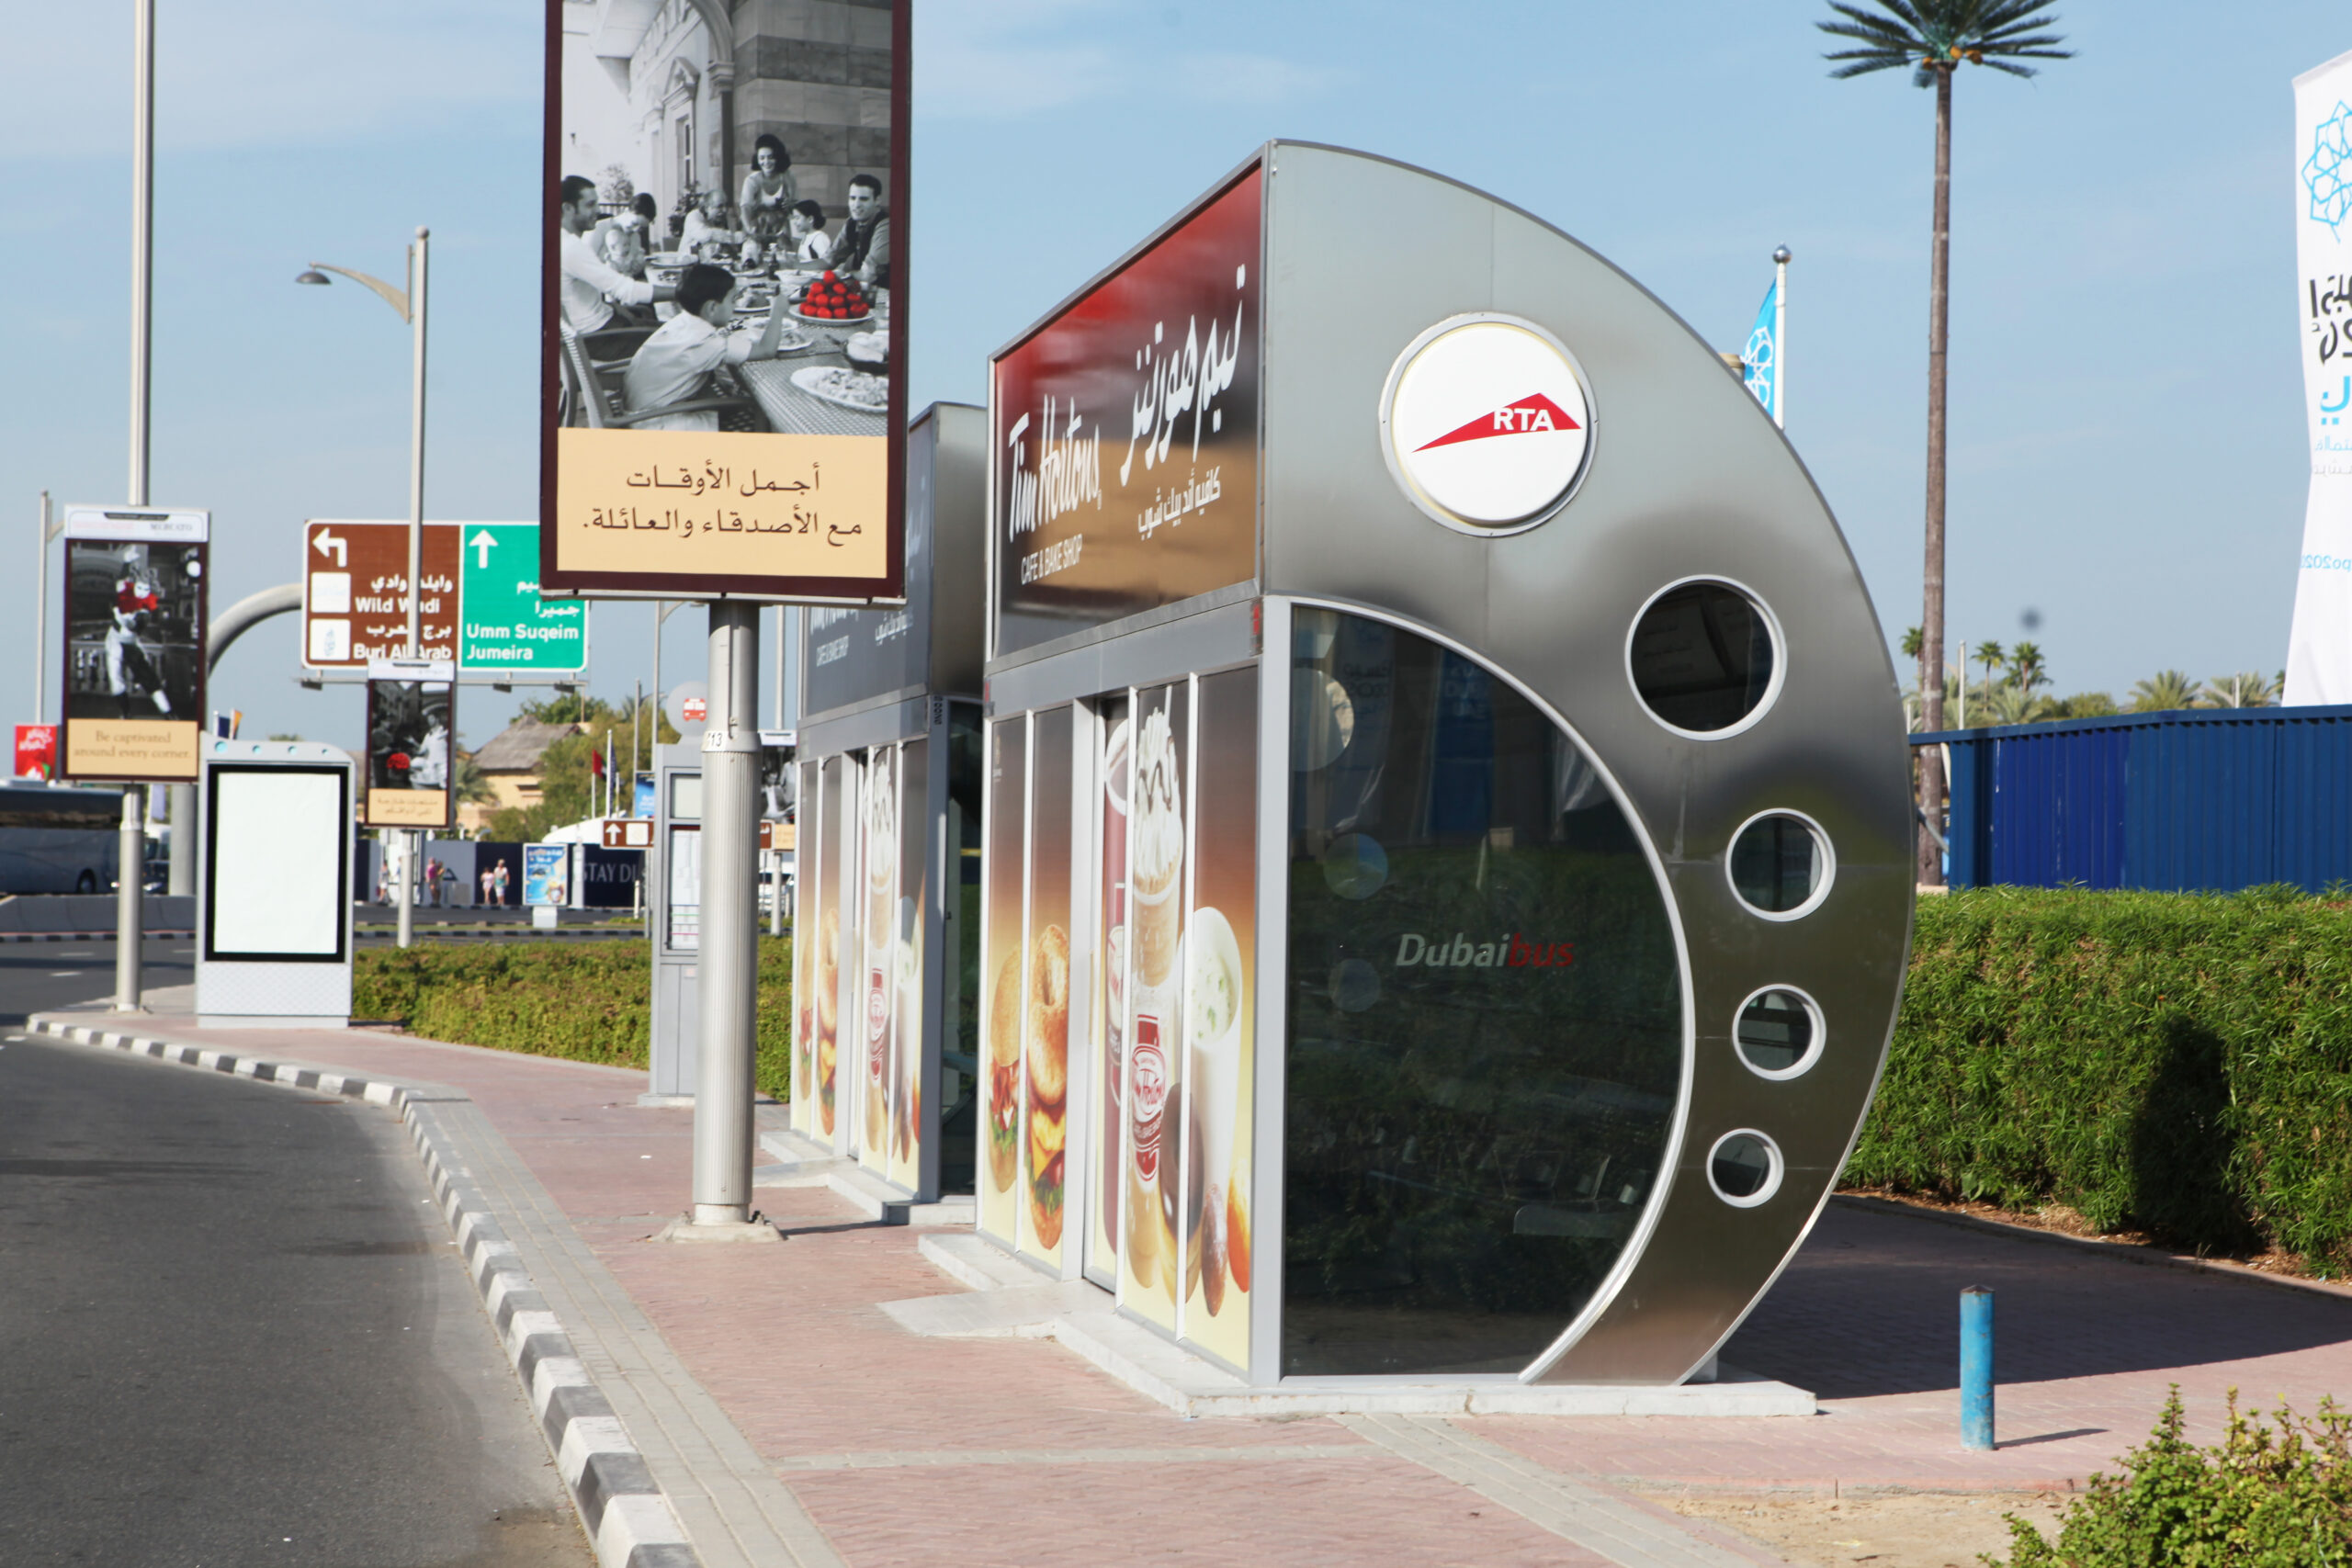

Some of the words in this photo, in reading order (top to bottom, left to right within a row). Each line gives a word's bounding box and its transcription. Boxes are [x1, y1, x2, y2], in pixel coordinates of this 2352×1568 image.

[1493, 407, 1555, 432] RTA
[627, 459, 730, 495] الأوقات
[741, 462, 820, 497] أجمل
[1009, 412, 1037, 544] Tim
[1037, 393, 1100, 527] Hortons
[702, 504, 819, 536] الأصدقاء
[826, 523, 863, 547] مع
[1021, 551, 1039, 585] CAFE
[355, 596, 394, 613] Wild
[398, 597, 441, 613] Wdi
[535, 600, 581, 618] جميرا
[466, 623, 511, 639] Umm
[514, 623, 580, 643] Suqeim
[466, 644, 534, 660] Jumeira
[112, 731, 172, 745] captivated
[1396, 931, 1575, 967] Dubaibus
